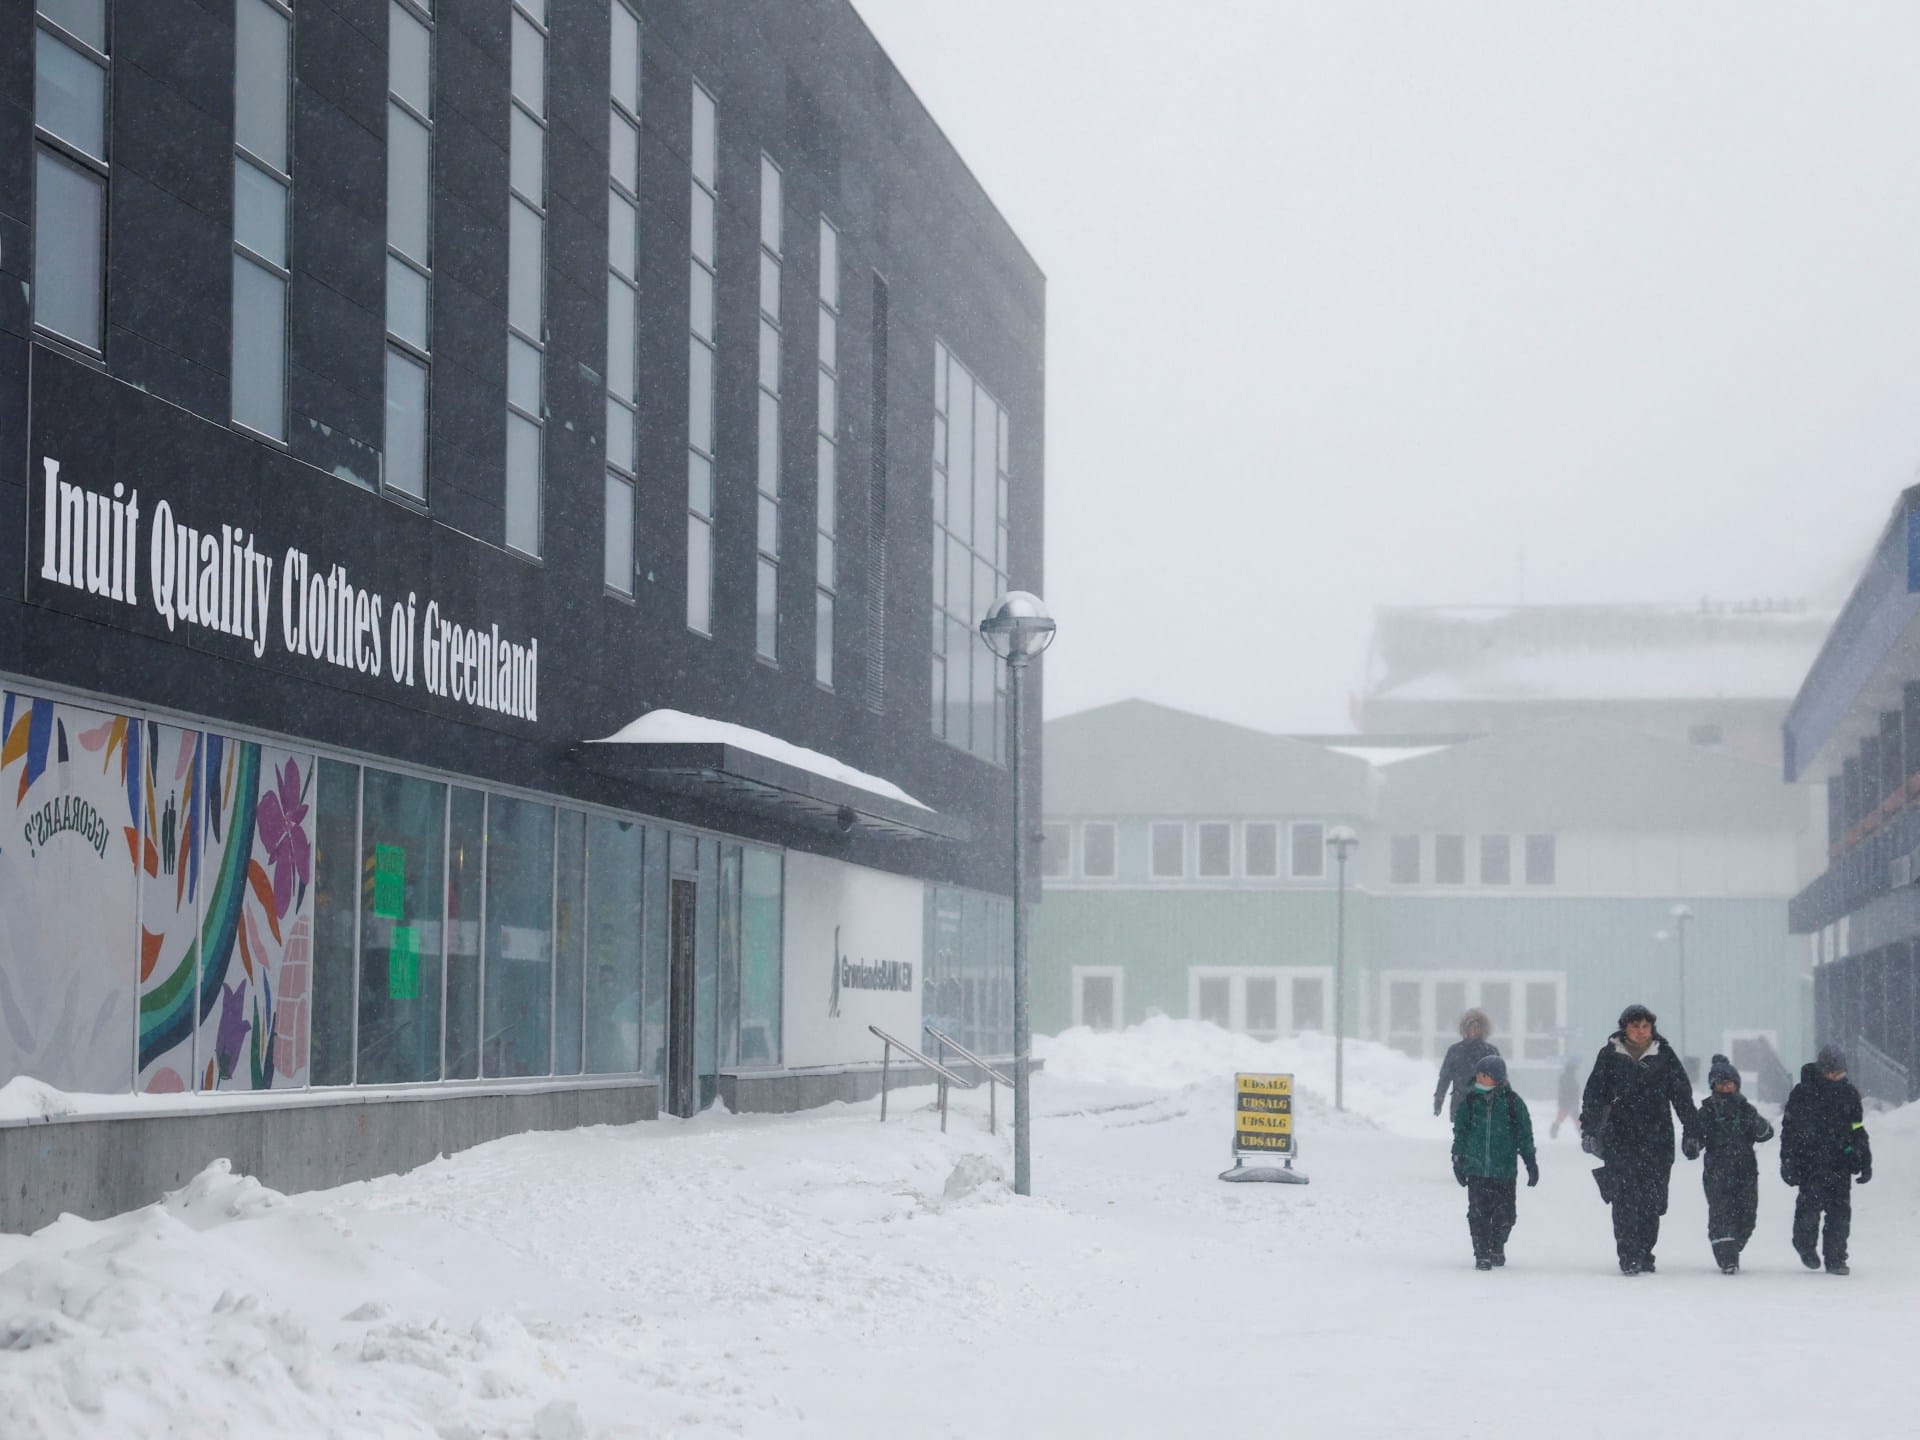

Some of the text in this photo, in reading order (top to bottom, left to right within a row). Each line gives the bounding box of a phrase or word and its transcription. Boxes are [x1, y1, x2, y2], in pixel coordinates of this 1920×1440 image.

[41, 456, 538, 722] Inuit Quality Clothes of Greenland
[1243, 1079, 1287, 1090] UDSALG
[1243, 1097, 1287, 1109] UDSALG
[1242, 1116, 1287, 1128] UDSALG
[1241, 1135, 1286, 1148] UDSALG
